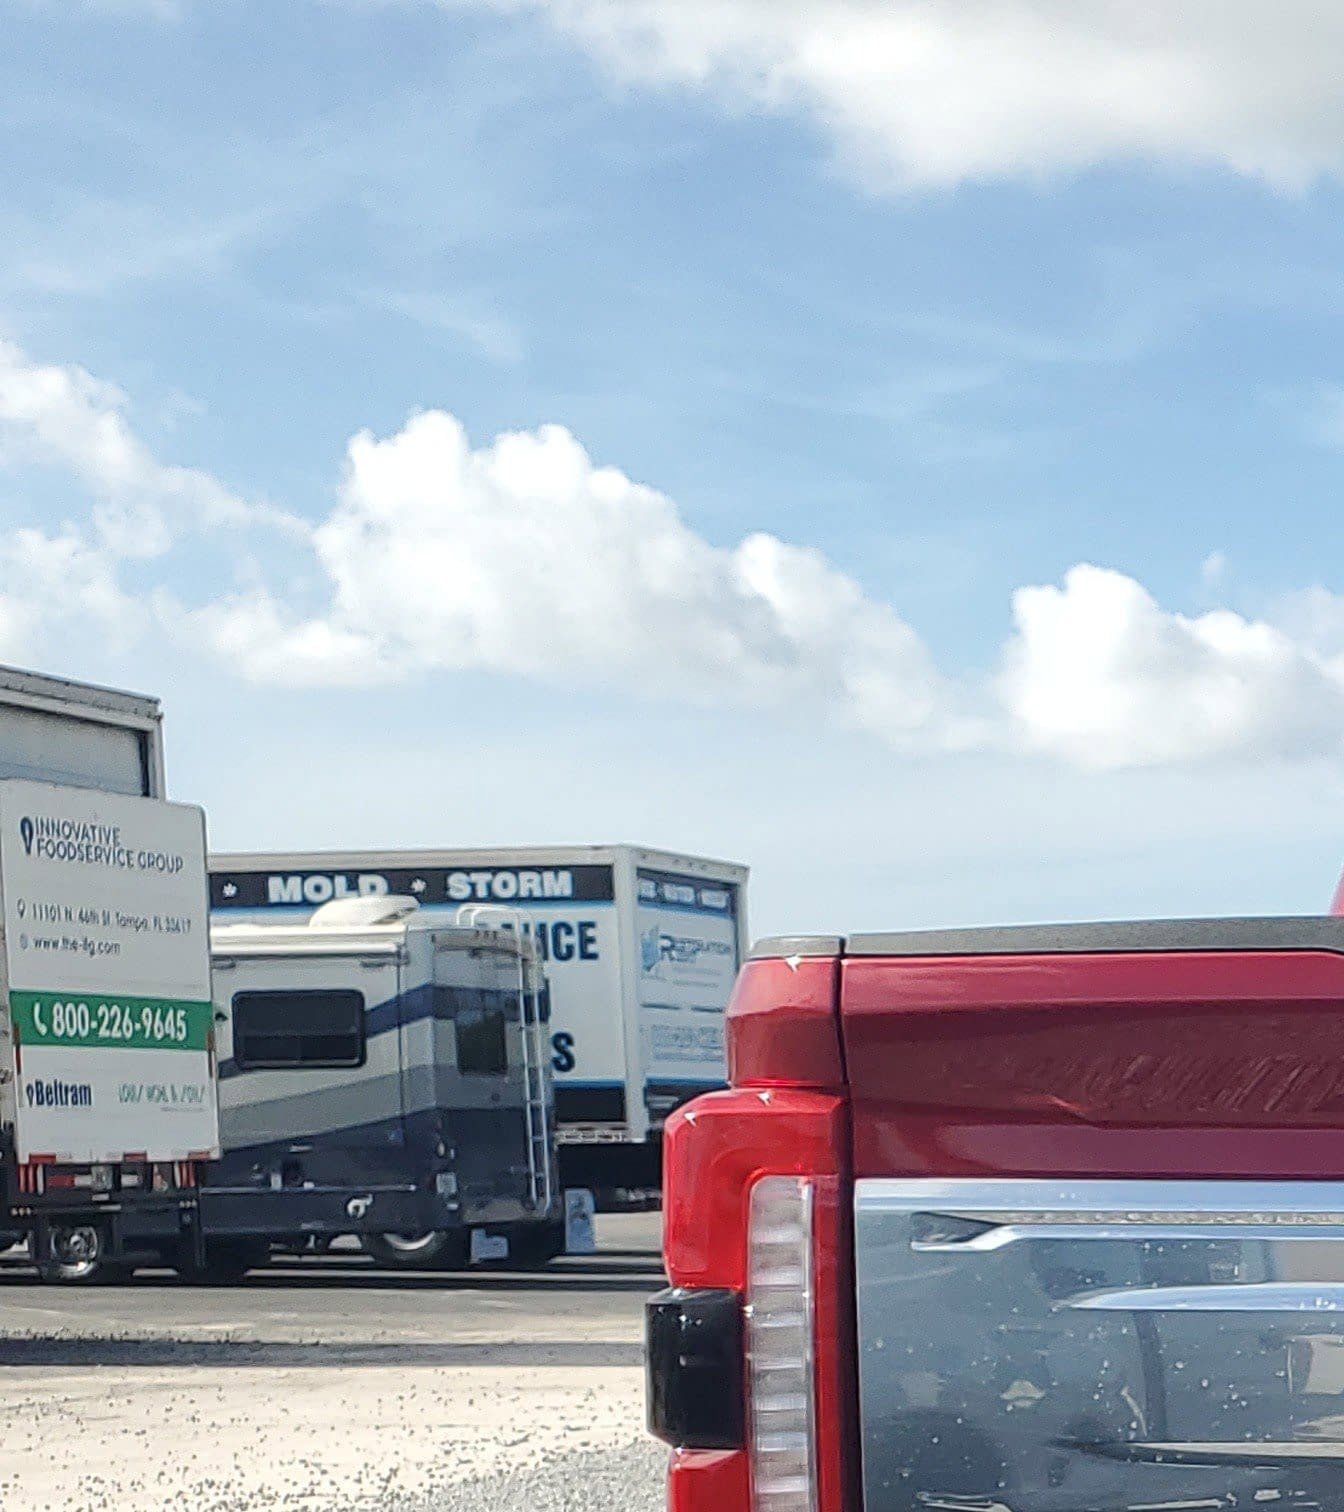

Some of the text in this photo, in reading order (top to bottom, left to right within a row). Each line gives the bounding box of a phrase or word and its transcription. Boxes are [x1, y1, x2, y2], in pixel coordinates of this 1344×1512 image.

[35, 816, 121, 847] INNOVATIVE
[37, 838, 184, 873] FOODSERVICE GROUP
[267, 871, 573, 903] MOLD STORM
[52, 1002, 187, 1042] 800-226-9645
[35, 1078, 92, 1107] Beltram
